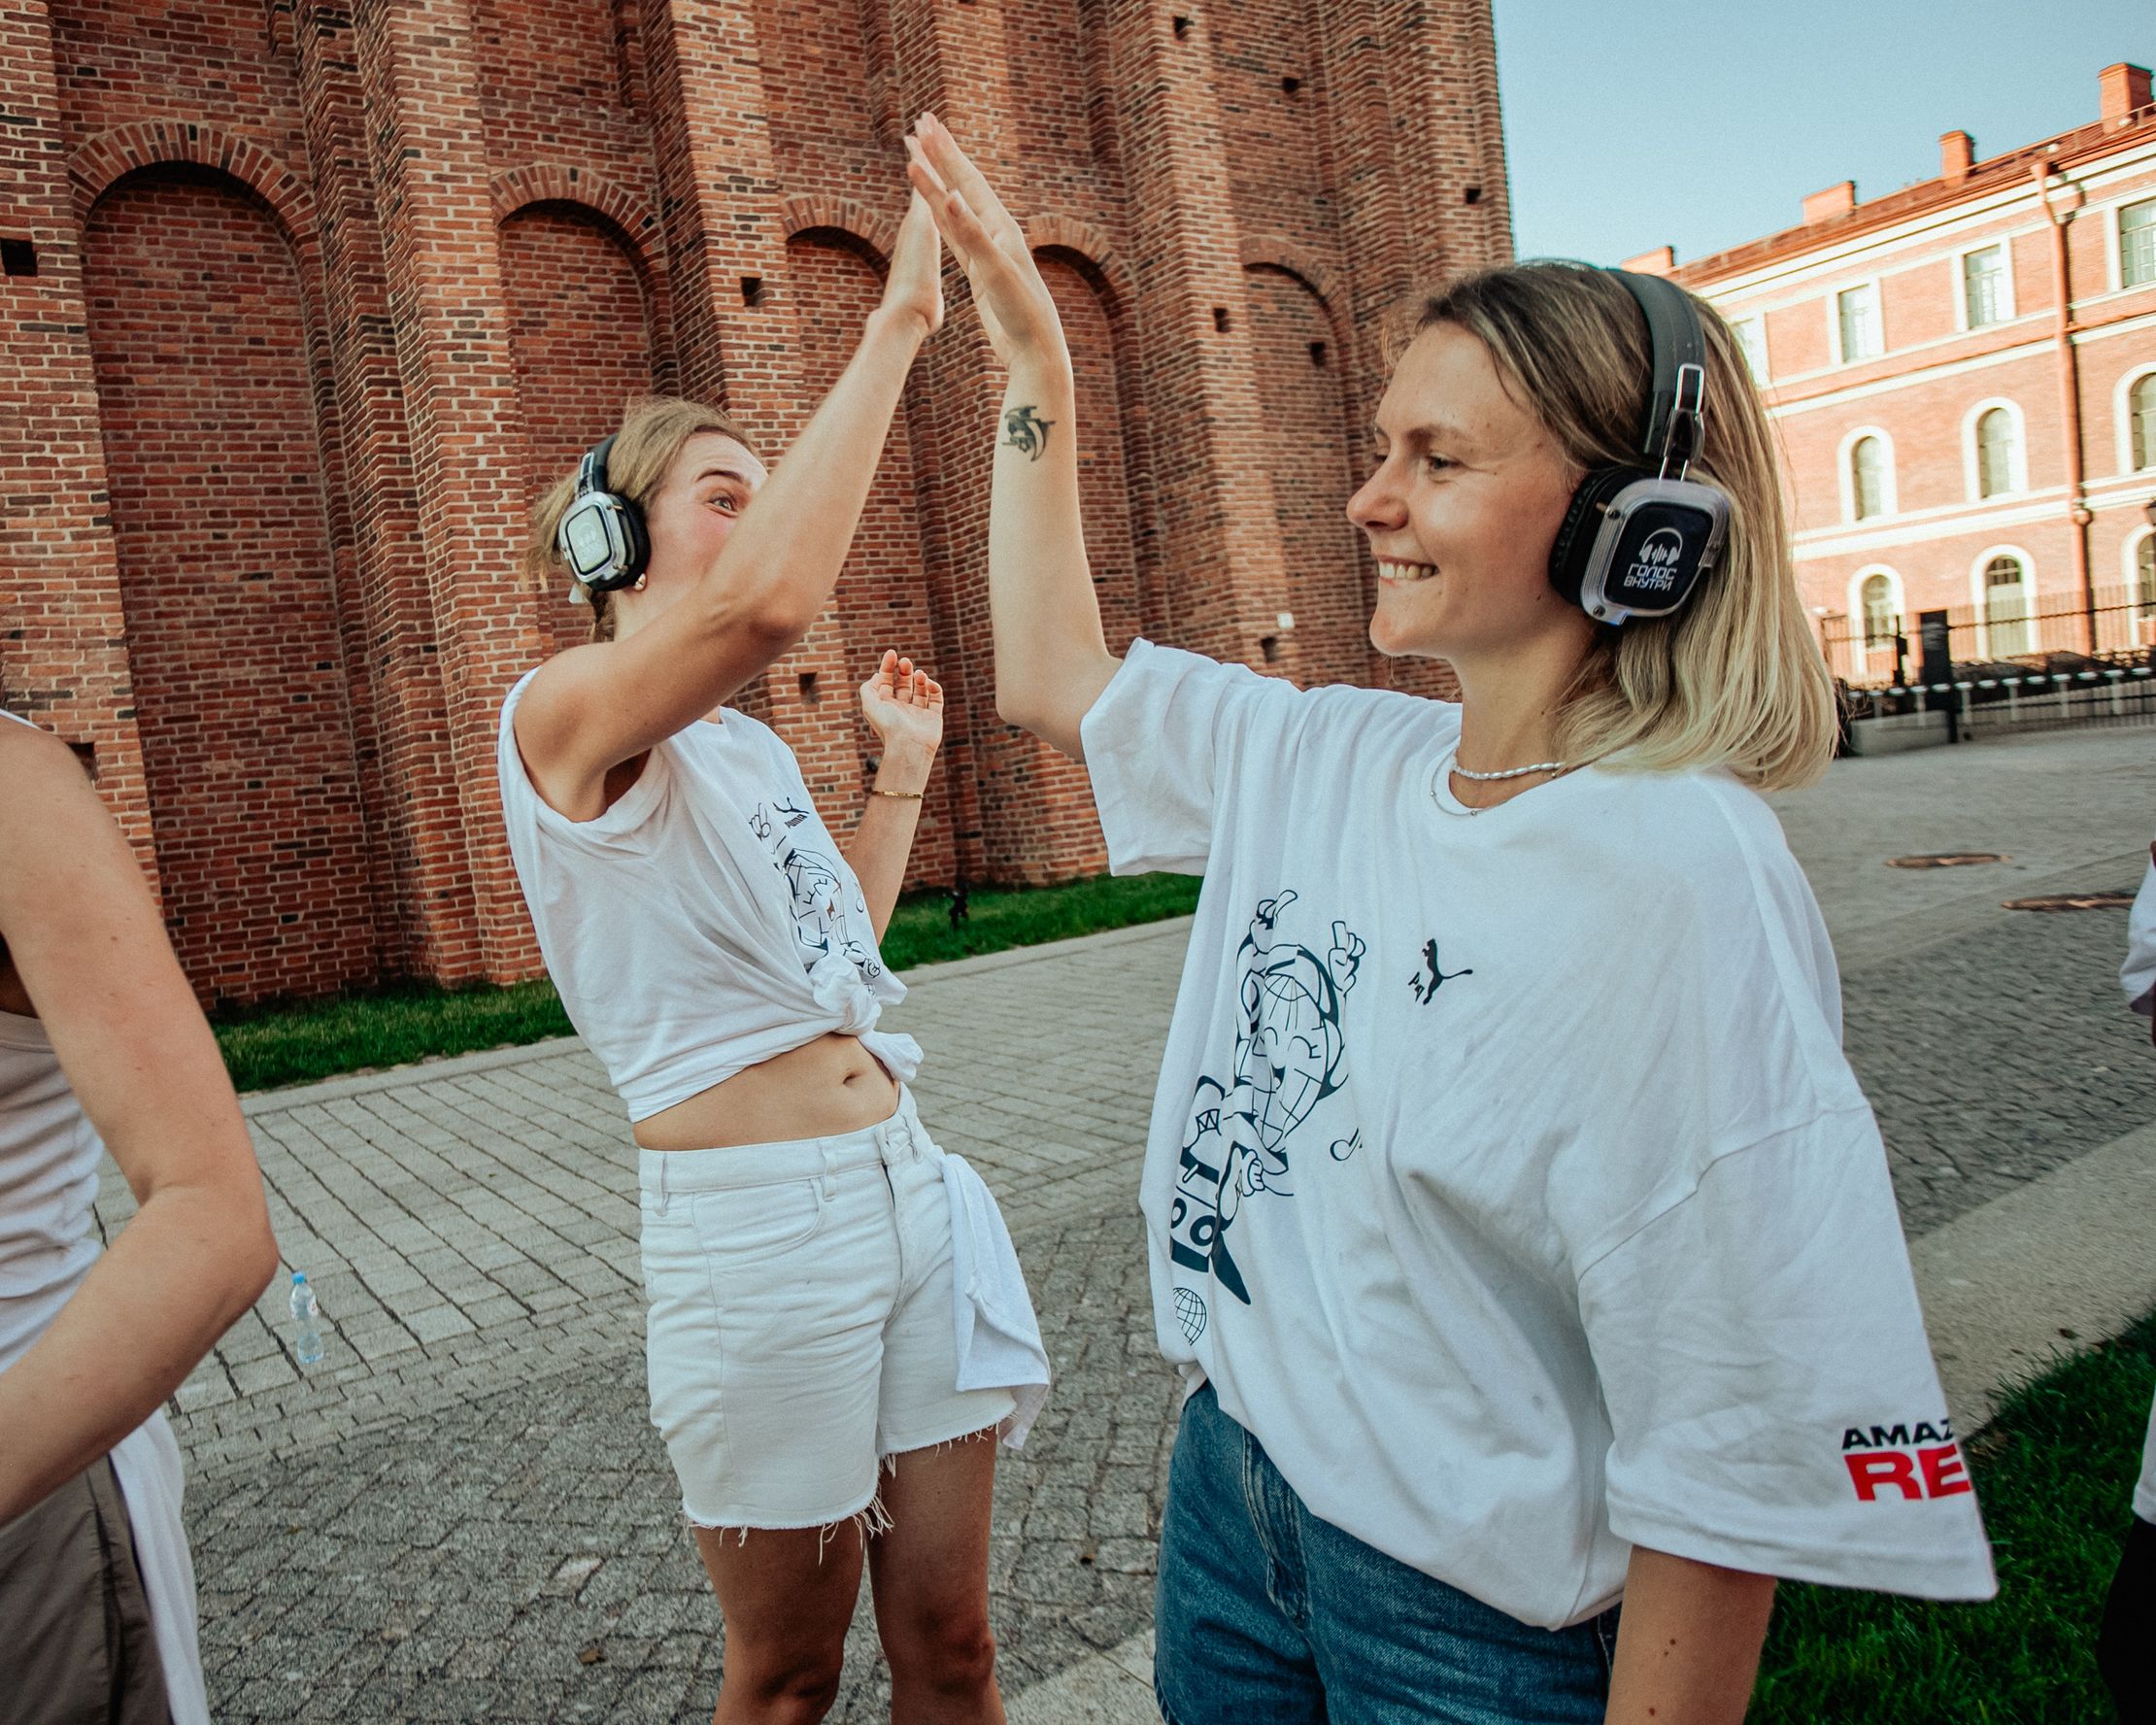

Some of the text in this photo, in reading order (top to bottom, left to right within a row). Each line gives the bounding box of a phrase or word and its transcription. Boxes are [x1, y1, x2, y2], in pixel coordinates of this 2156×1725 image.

[1626, 563, 1677, 580] ГОЛОС
[1624, 577, 1673, 592] ВНУТРИ
[1844, 1443, 1973, 1502] RE
